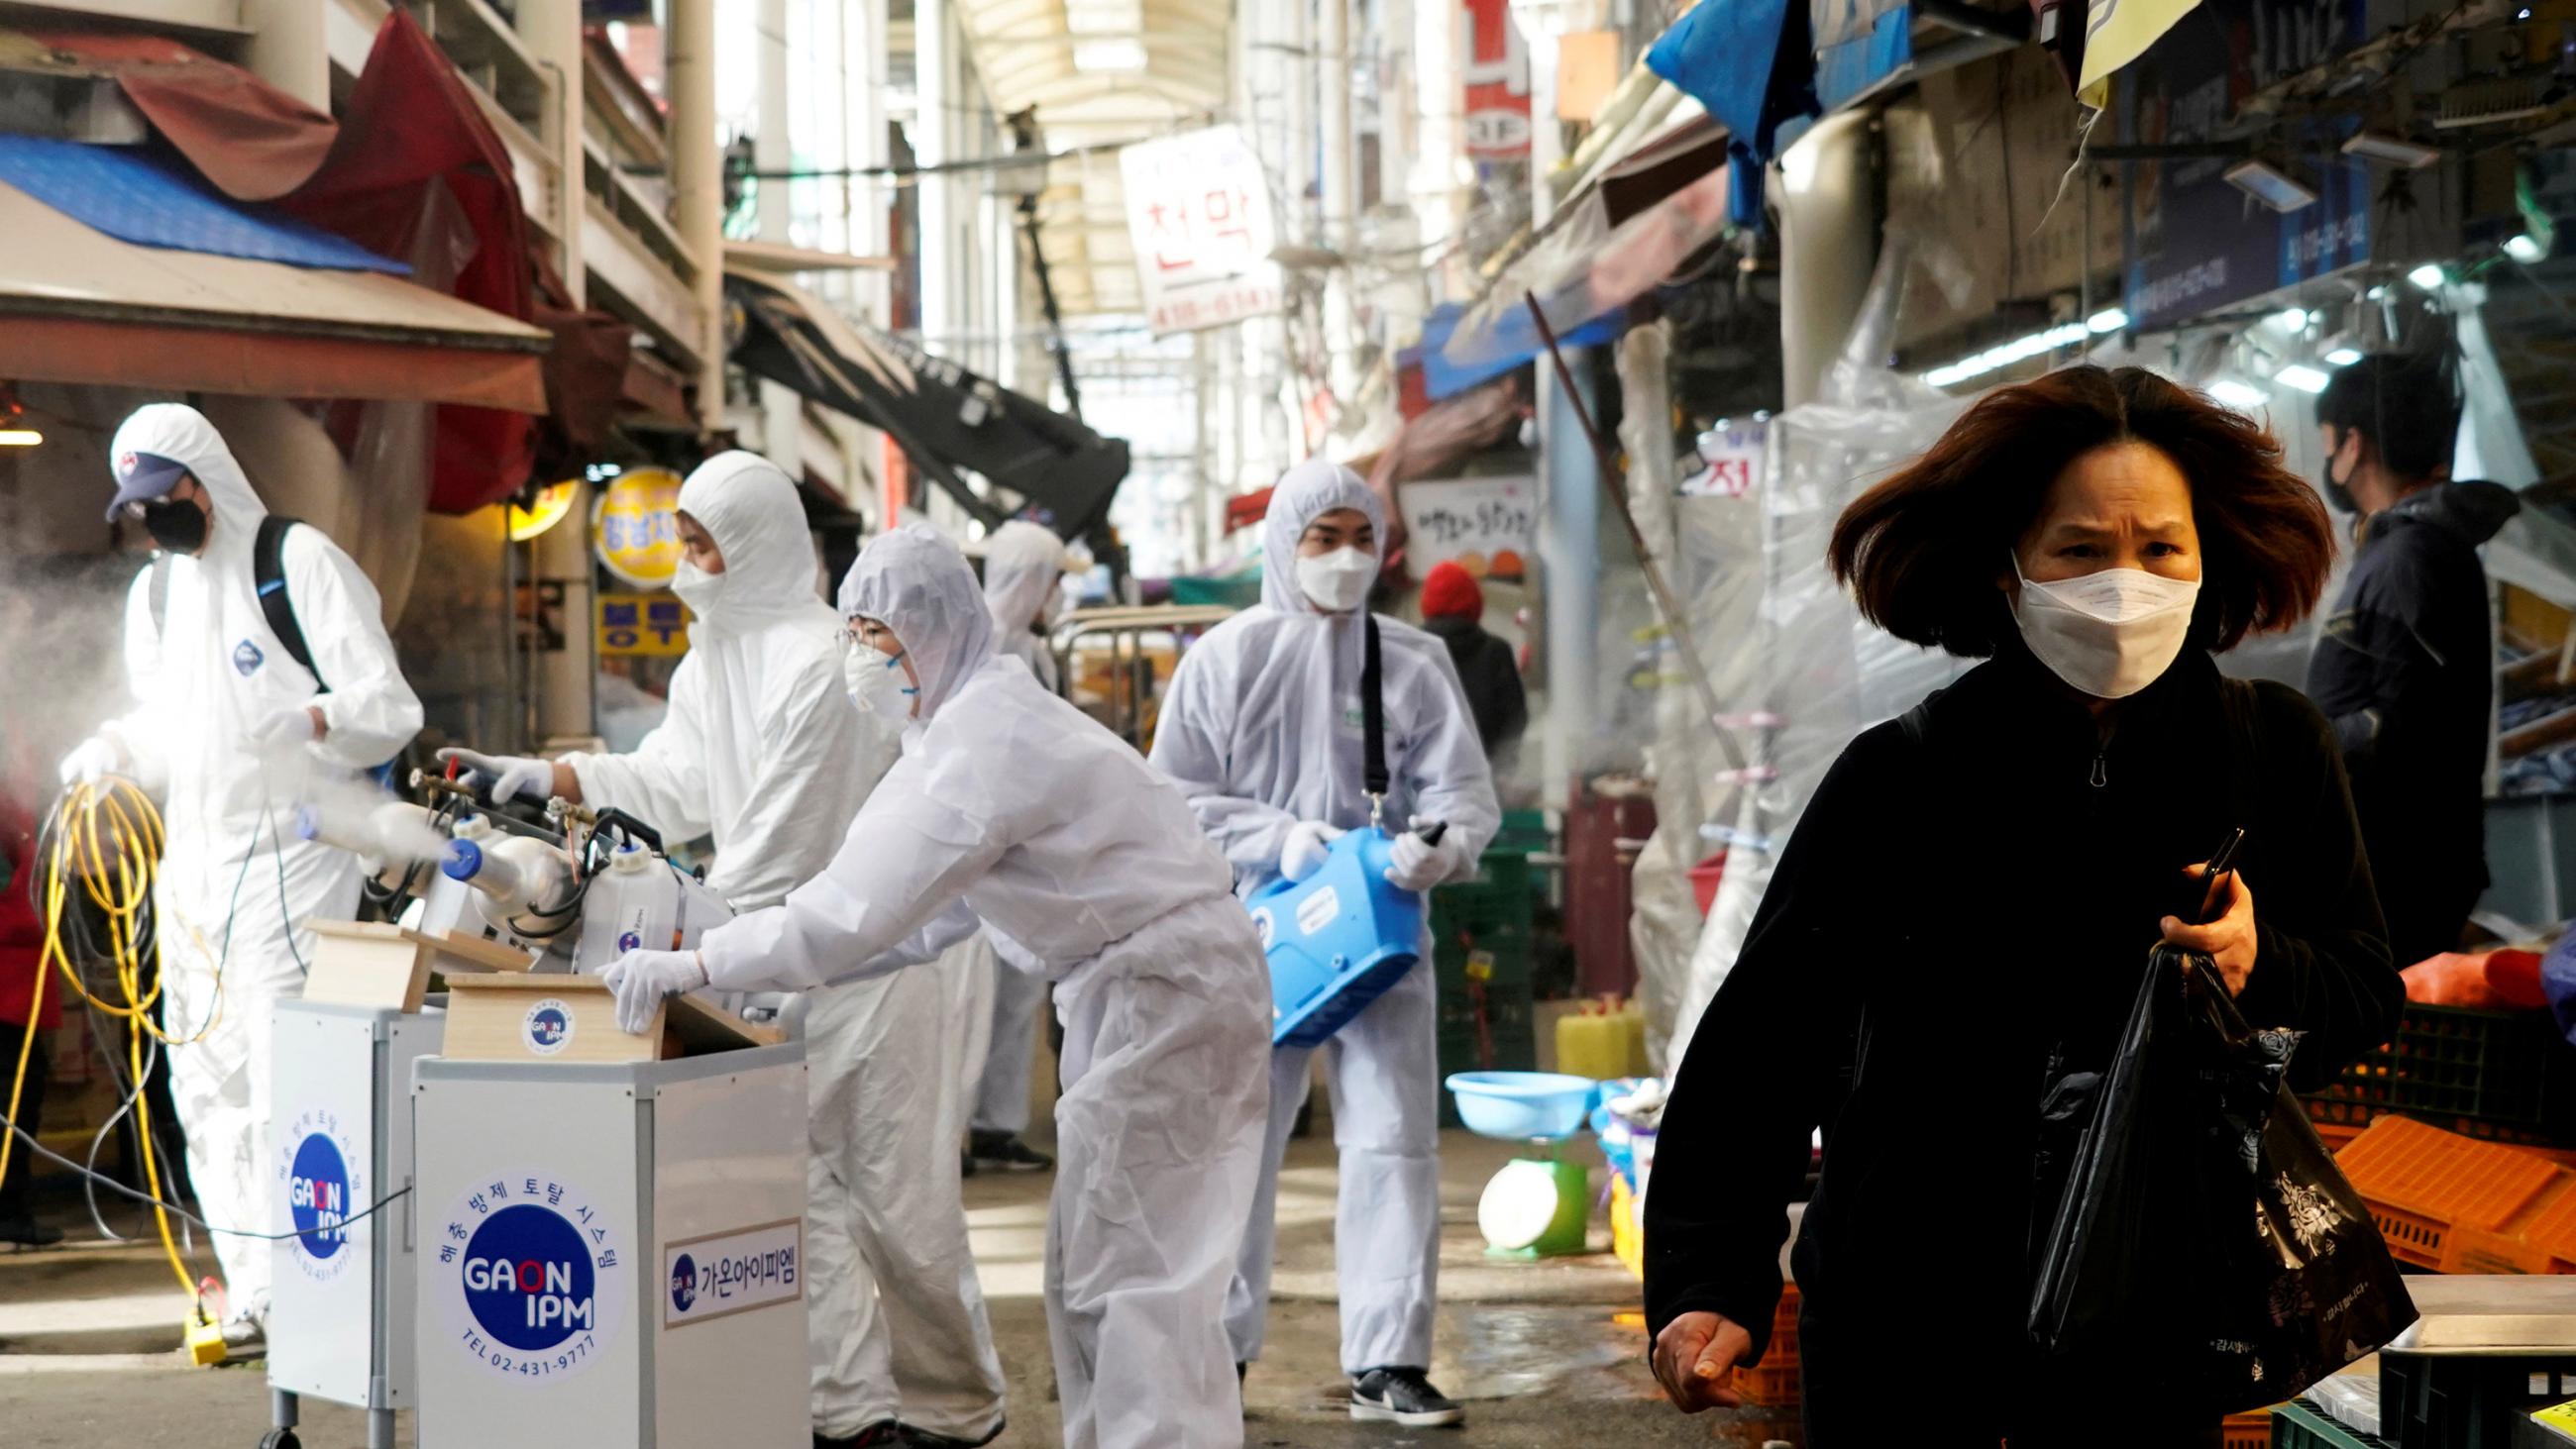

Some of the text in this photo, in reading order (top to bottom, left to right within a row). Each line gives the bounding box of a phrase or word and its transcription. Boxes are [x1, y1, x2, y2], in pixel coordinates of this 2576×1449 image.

[1147, 184, 1252, 271] 천막
[603, 602, 682, 648] 봉투
[532, 1021, 561, 1032] GAON
[546, 1030, 565, 1041] IPM
[290, 1176, 342, 1212] GAON
[316, 1209, 350, 1243] IPM
[440, 1178, 618, 1269] 해충 방제 토탈 시스템
[464, 1257, 572, 1294] GAON
[701, 1245, 796, 1298] 가온아이피엠
[527, 1294, 593, 1329] IPM
[462, 1327, 594, 1376] TEL 02-431-9777
